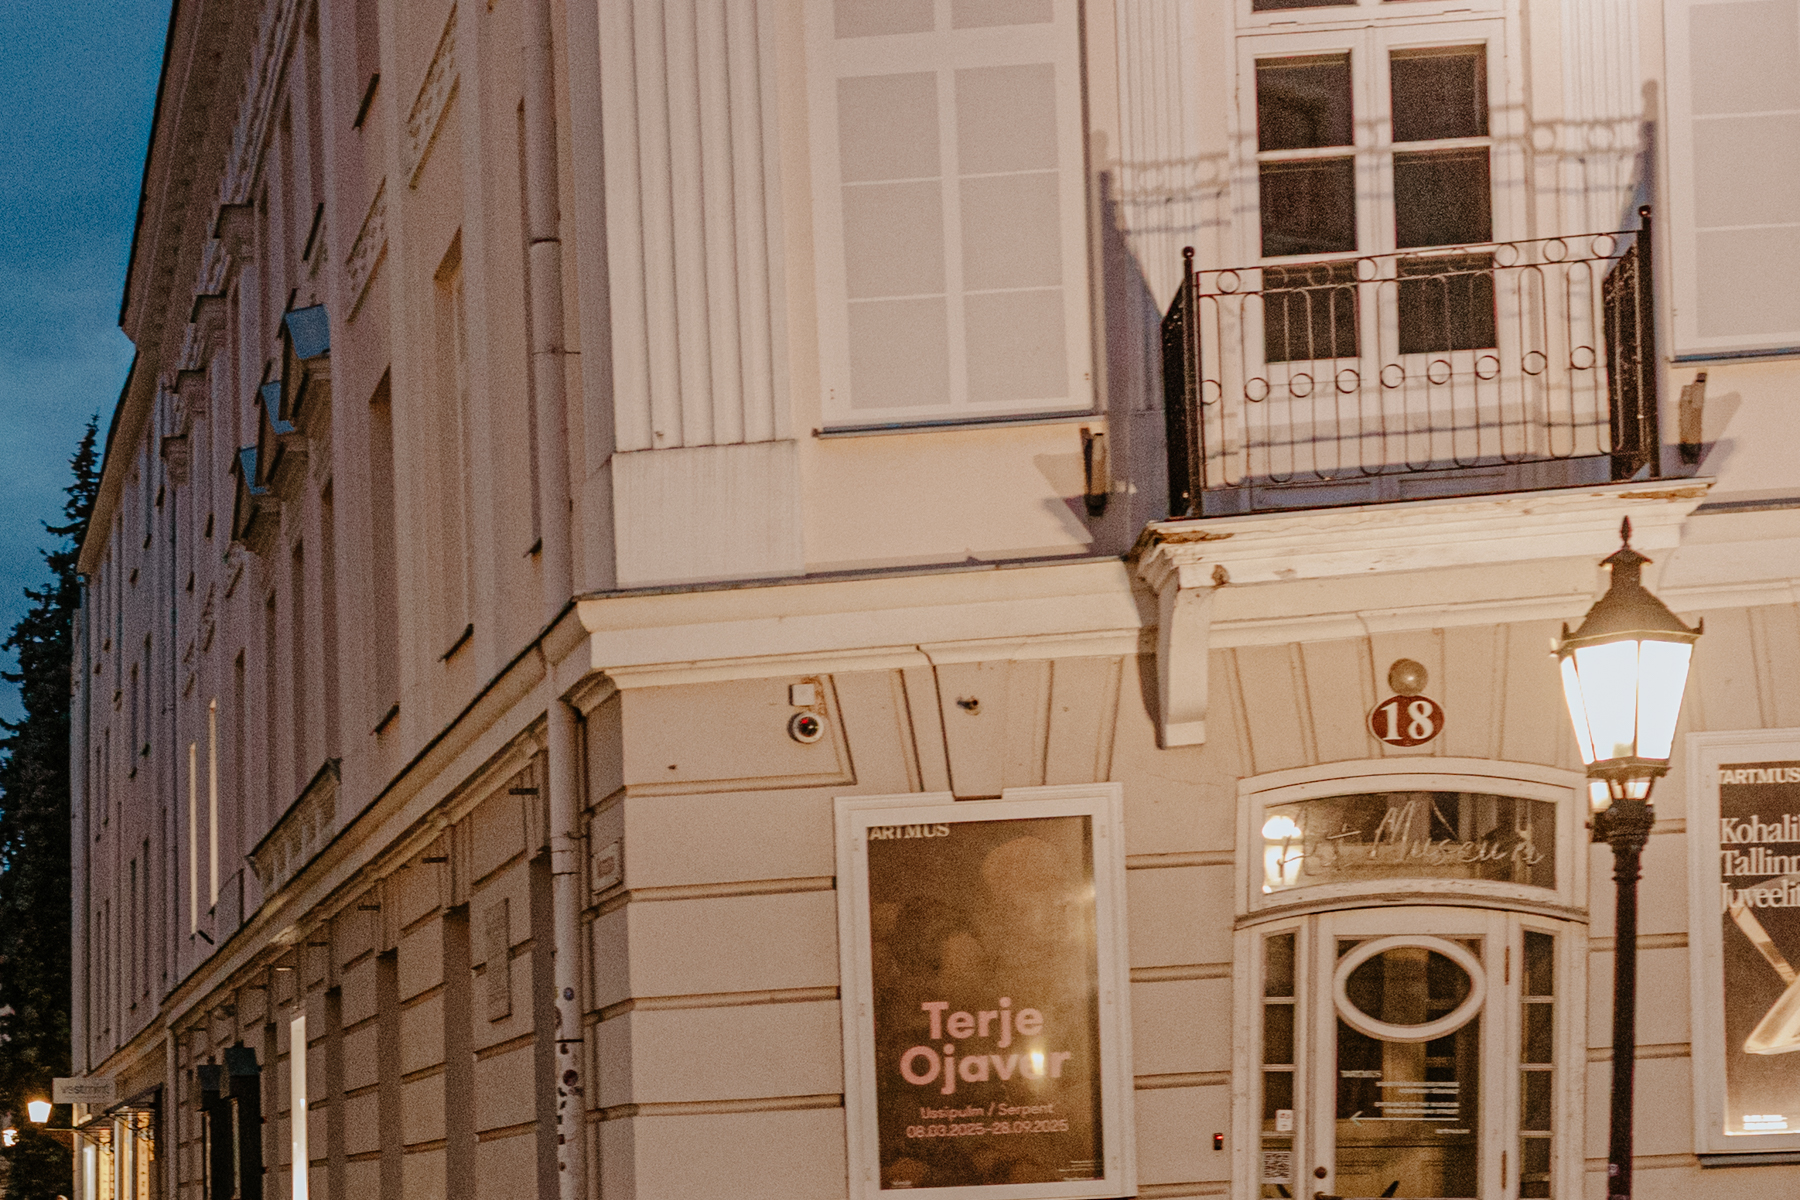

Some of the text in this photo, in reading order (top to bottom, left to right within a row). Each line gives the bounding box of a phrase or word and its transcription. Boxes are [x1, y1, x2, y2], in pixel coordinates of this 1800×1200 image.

[1380, 700, 1435, 741] 18
[1720, 814, 1800, 844] Kohali
[1720, 878, 1800, 914] Juveeli
[920, 996, 1045, 1049] Terje
[899, 1042, 1072, 1096] Ojaver
[998, 1101, 1054, 1118] Serpent
